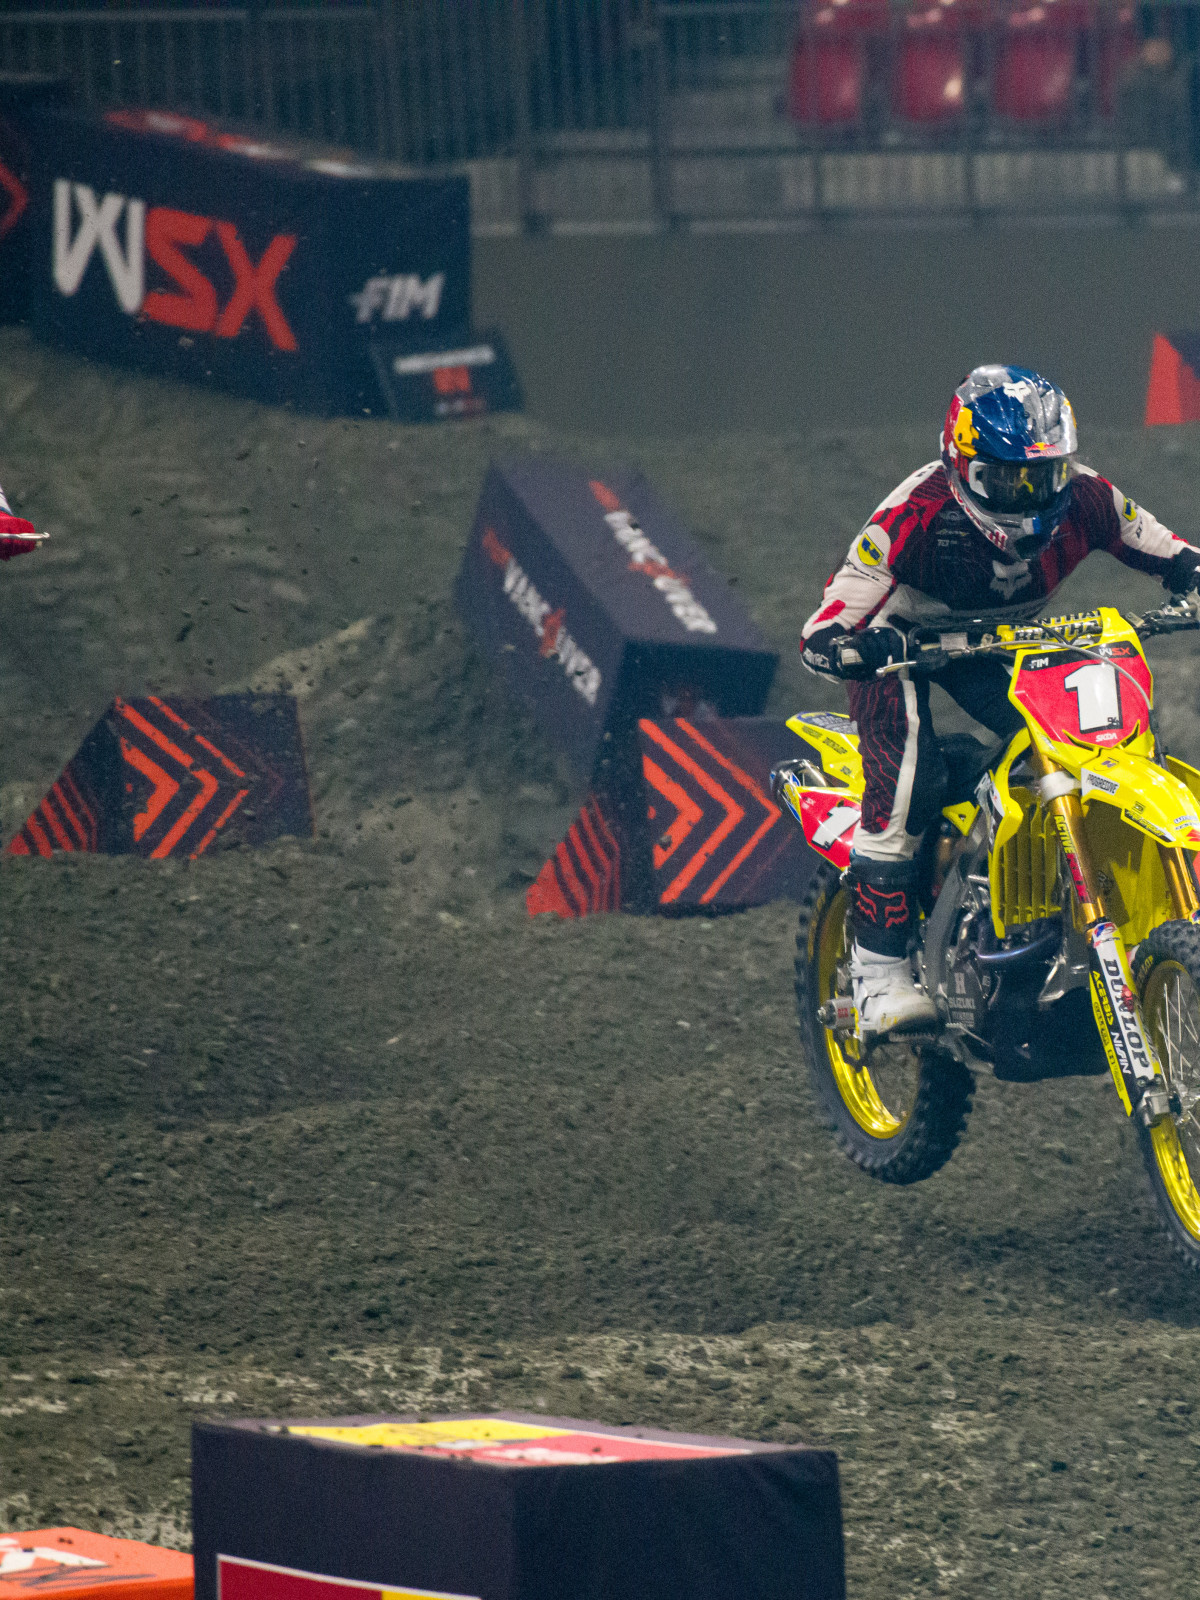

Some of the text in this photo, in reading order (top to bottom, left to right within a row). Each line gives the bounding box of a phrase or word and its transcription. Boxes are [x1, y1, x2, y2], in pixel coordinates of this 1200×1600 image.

[53, 178, 296, 351] WSX
[351, 273, 444, 323] FIM
[1029, 657, 1049, 669] FIM
[1098, 646, 1132, 657] WSX
[1064, 662, 1123, 733] 1
[1054, 815, 1077, 854] ACTIVE
[1092, 970, 1113, 1026] ACERBIS
[1103, 958, 1150, 1068] DUNLOP
[1111, 1031, 1131, 1075] NISSIN
